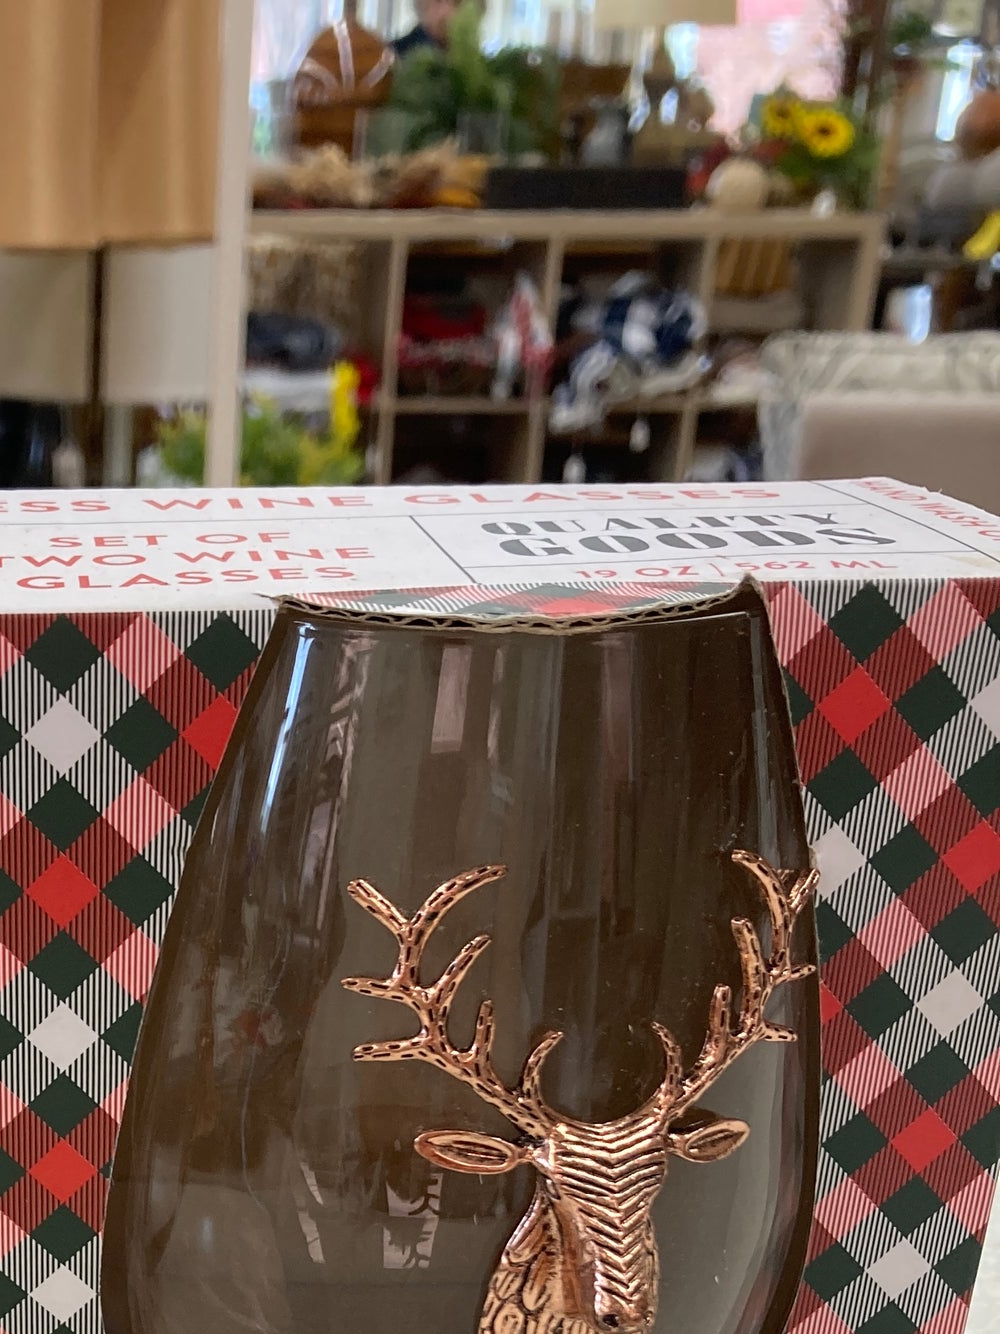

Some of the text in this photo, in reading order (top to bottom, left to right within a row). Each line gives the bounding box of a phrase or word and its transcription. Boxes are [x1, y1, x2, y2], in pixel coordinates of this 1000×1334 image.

[143, 495, 374, 511] WINE
[403, 489, 780, 505] GLASSES
[480, 513, 840, 537] QUALITY
[911, 502, 997, 527] WASH
[50, 532, 291, 548] SET OF
[499, 528, 897, 558] GOODS
[174, 547, 375, 563] WINE
[16, 567, 355, 589] GLASSES
[576, 569, 617, 578] 19
[635, 565, 699, 577] OZ
[734, 560, 816, 571] 562
[829, 560, 897, 570] ML
